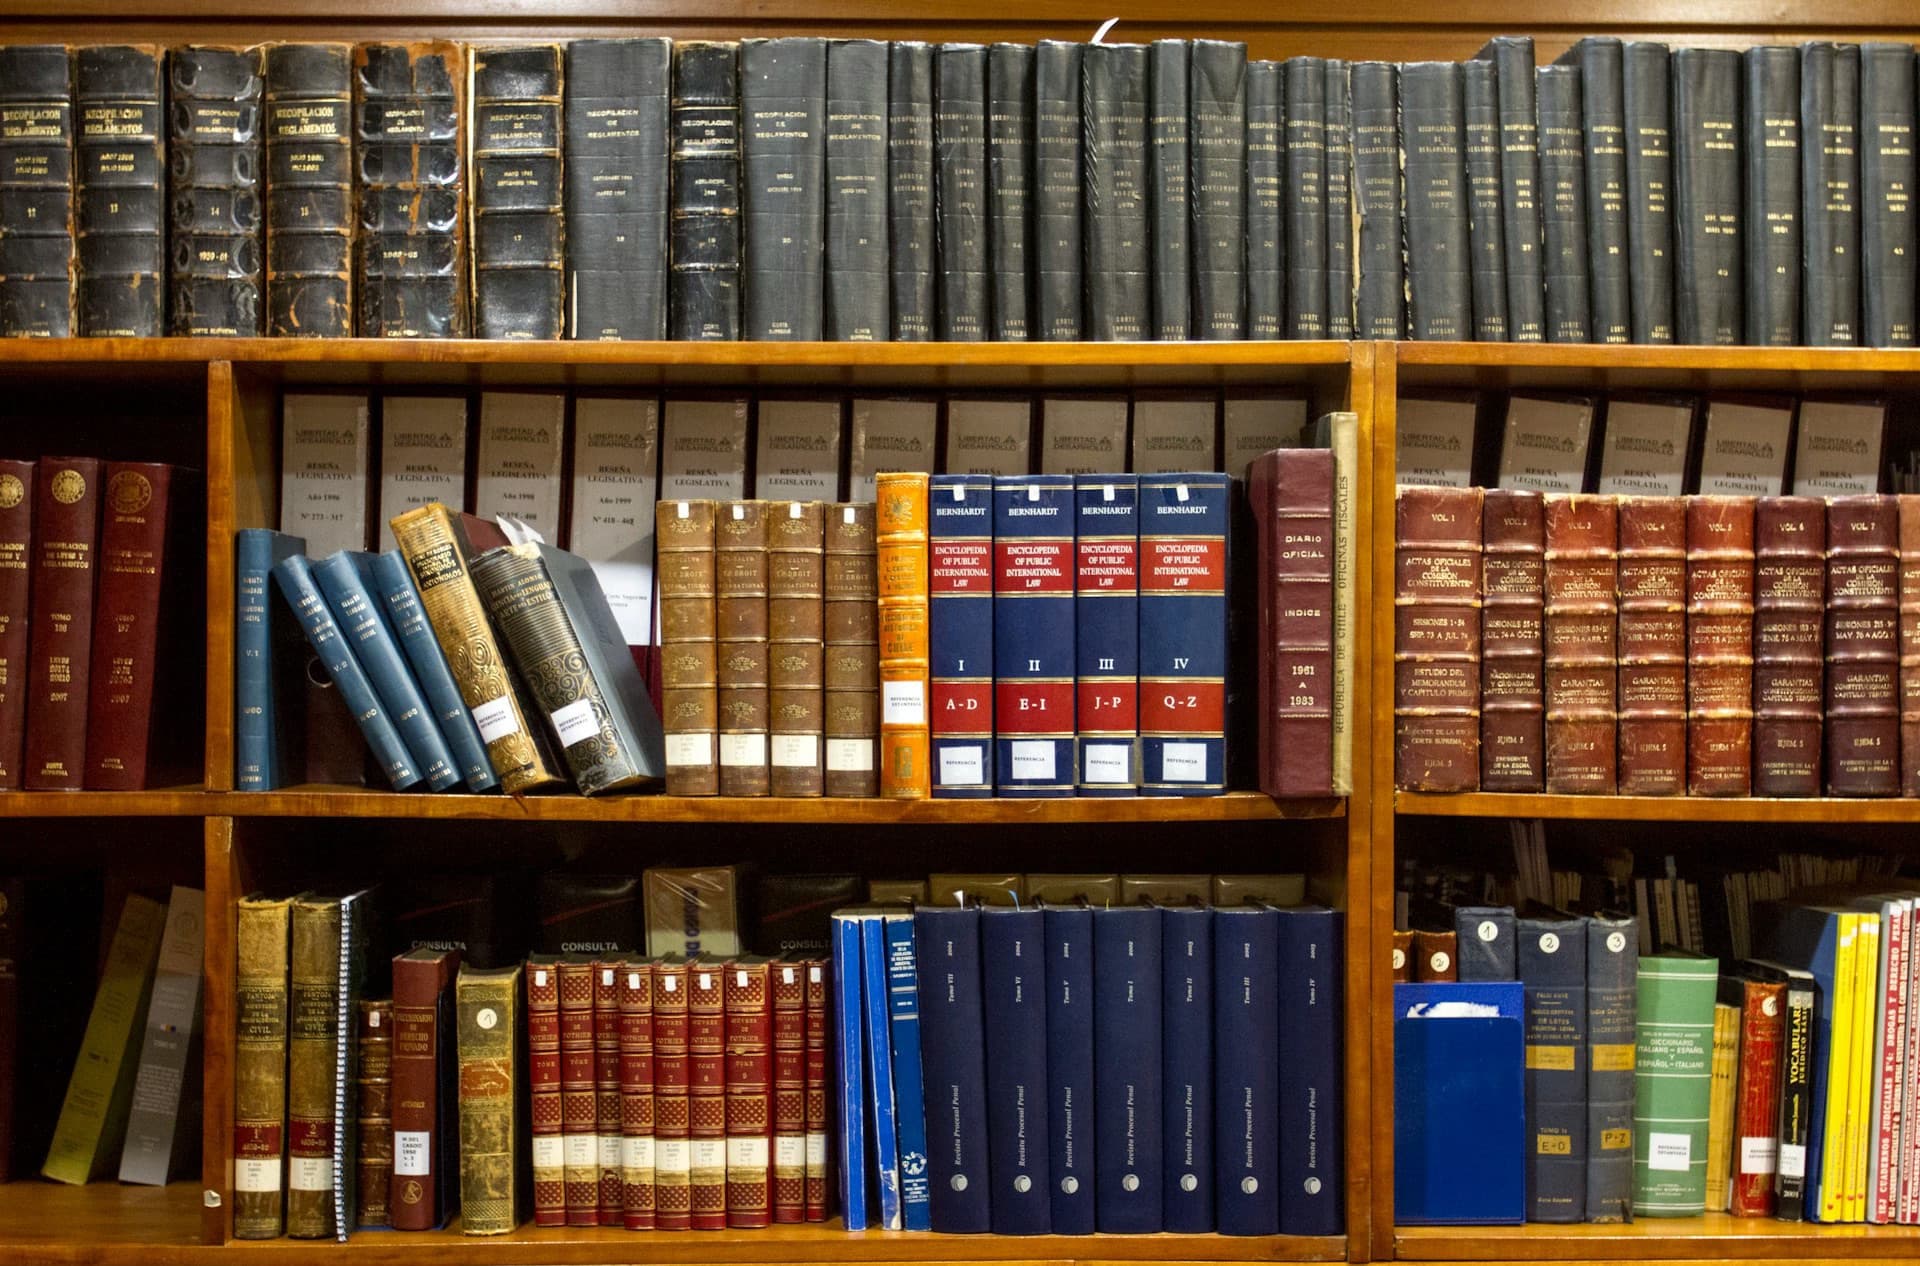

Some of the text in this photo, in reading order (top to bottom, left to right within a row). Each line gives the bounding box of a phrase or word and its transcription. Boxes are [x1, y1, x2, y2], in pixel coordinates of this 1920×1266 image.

[936, 507, 987, 516] BERNHARDT
[1008, 507, 1059, 516] BERNHARDT
[1082, 506, 1132, 515] BERNHARDT
[1157, 506, 1208, 515] BERNHARDT
[1431, 513, 1450, 522] VOL.
[1285, 535, 1322, 543] DIARIO
[935, 546, 987, 555] ENCYCLOPEDIA
[1007, 546, 1060, 555] ENCYCLOPEDIA
[1080, 545, 1133, 554] ENCYCLOPEDIA
[1155, 544, 1208, 553] ENCYCLOPEDIA
[1163, 555, 1200, 564] OF PUBLIC
[1282, 550, 1325, 559] OFICIAL
[942, 557, 980, 566] OF PUBLIC
[1015, 557, 1052, 566] OF PUBLIC
[1088, 556, 1125, 565] OF PUBLIC
[1405, 557, 1472, 567] ACTAS OFICIALES
[933, 567, 989, 577] INTERNATIONAL
[1006, 567, 1061, 577] INTERNATIONAL
[1079, 566, 1135, 576] INTERNATIONAL
[1154, 566, 1210, 576] INTERNATIONAL
[1830, 565, 1857, 575] ACTAS
[953, 579, 968, 588] LAW
[1026, 579, 1041, 588] LAW
[1098, 577, 1114, 586] LAW
[1173, 577, 1189, 586] LAW
[1407, 579, 1473, 588] CONSTITUYENTE
[1335, 476, 1348, 734] REPUBLICA DE CHILE OFICINAS FISCALES
[1285, 609, 1321, 617] INDICE
[958, 660, 965, 672] I
[1028, 659, 1041, 672] II
[1098, 658, 1114, 670] III
[1173, 658, 1189, 670] IV
[1292, 665, 1315, 676] 1961
[1414, 668, 1465, 677] ESTUDIO DEL
[1411, 679, 1466, 688] MEMORANDUM
[1560, 679, 1605, 688] GARANTIAS
[1771, 678, 1814, 687] GARANTIAS
[1846, 674, 1890, 684] GARANTIAS
[1298, 681, 1307, 689] A
[1289, 695, 1314, 706] 1983
[1484, 925, 1492, 938] 1
[1892, 914, 1901, 942] PENA
[411, 940, 467, 951] CONSULTA
[561, 942, 619, 952] CONSULTA
[1544, 937, 1554, 949] 2
[1612, 936, 1622, 948] 3
[1435, 957, 1445, 967] 2
[1889, 947, 1900, 991] DERECHO
[1015, 976, 1021, 987] VI
[1186, 976, 1193, 985] II
[1309, 978, 1317, 1006] Tomo IV
[249, 1025, 272, 1034] CIVIL
[304, 1023, 327, 1031] CIVIL
[1886, 1008, 1897, 1047] DROGAS
[1649, 1038, 1694, 1046] DICCIONARIO
[1789, 994, 1801, 1084] VOCABULARIO
[1064, 1086, 1072, 1108] Penal
[1308, 1087, 1316, 1108] Penal
[1883, 1077, 1893, 1132] JUDICIALES
[952, 1085, 962, 1166] Revista Procesal Penal
[1016, 1085, 1026, 1167] Revista Procesal Penal
[1127, 1085, 1135, 1166] Revista Procesal Penal
[1185, 1084, 1193, 1166] Revista Procesal Penal
[1244, 1087, 1253, 1168] Revista Procesal Penal
[1065, 1140, 1073, 1168] Revista
[1880, 1137, 1890, 1193] CUADERNOS
[1878, 1198, 1888, 1214] IEJ
